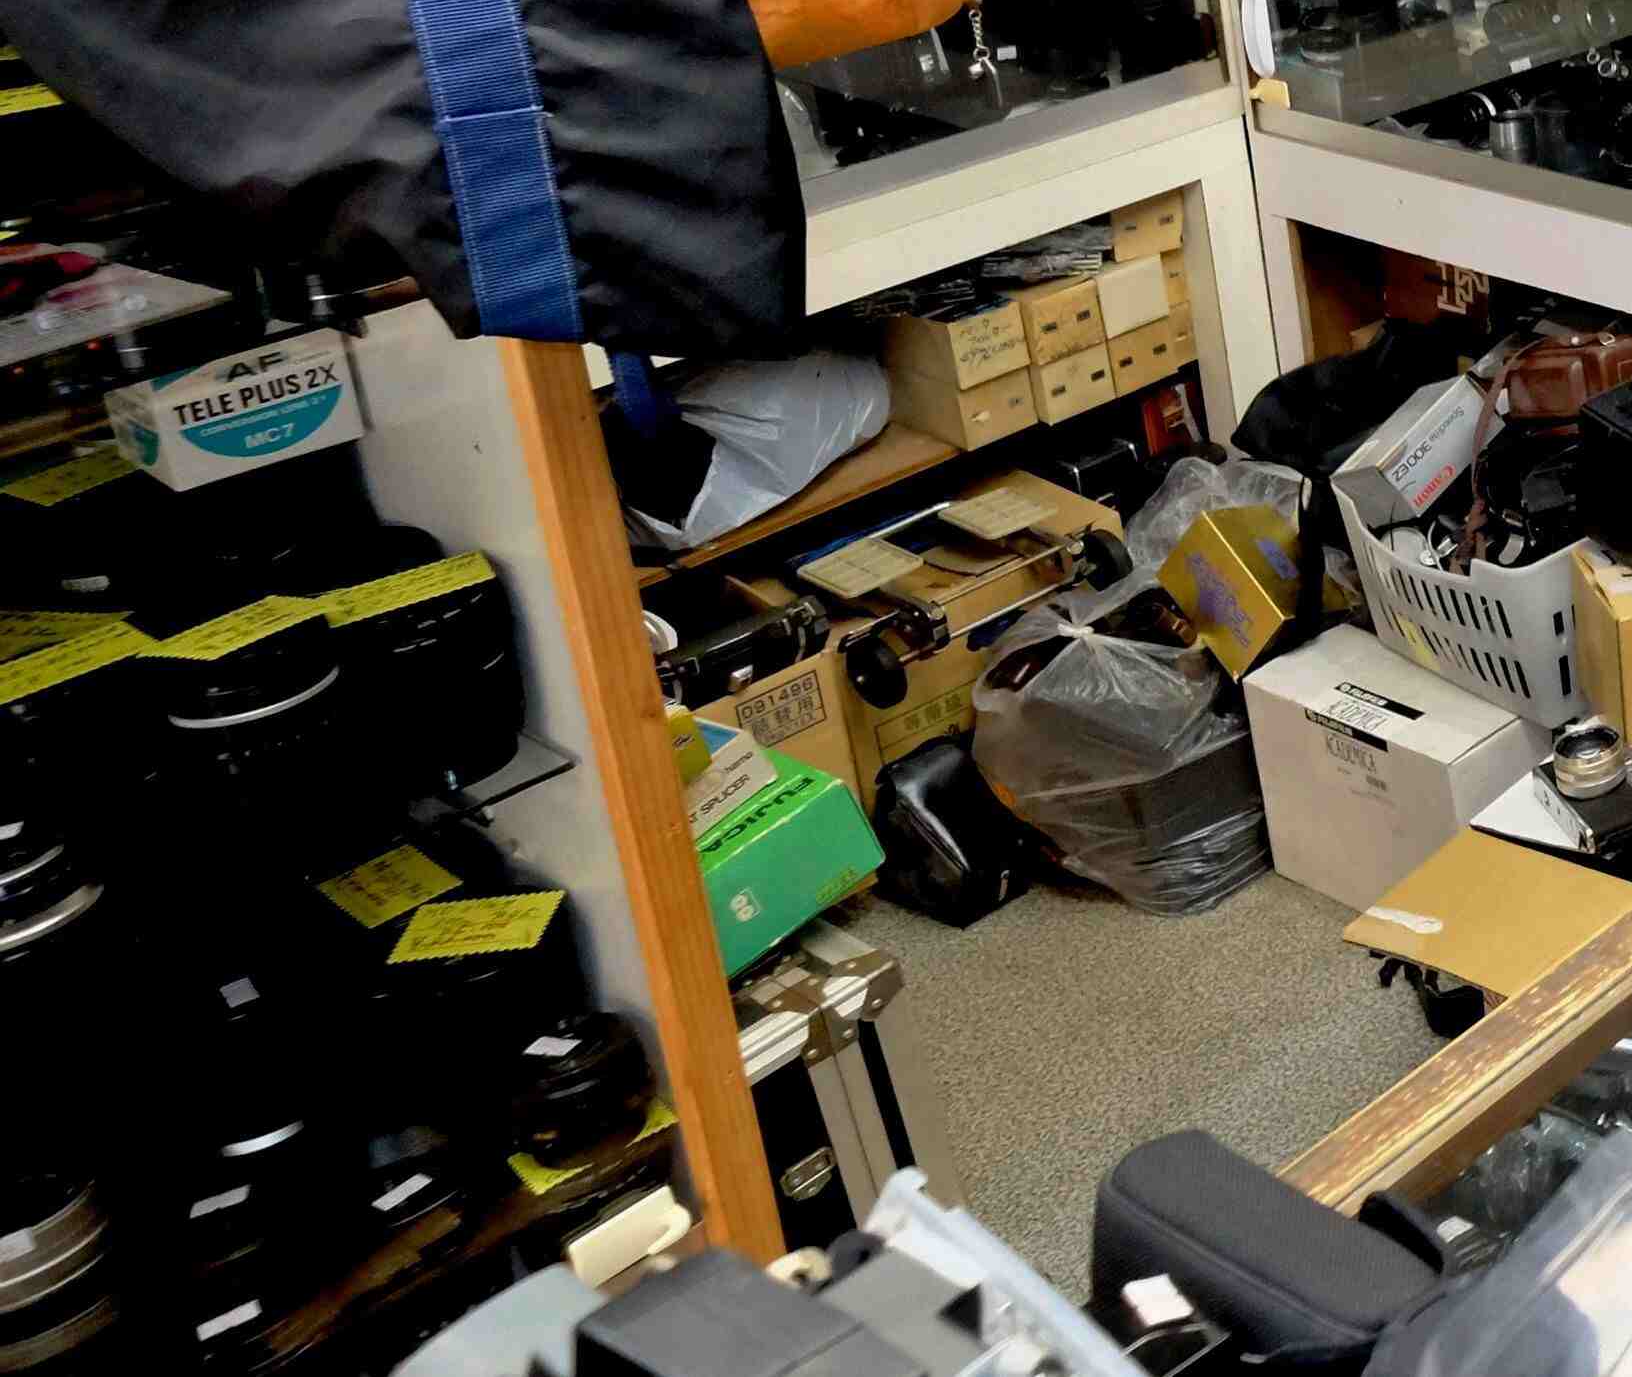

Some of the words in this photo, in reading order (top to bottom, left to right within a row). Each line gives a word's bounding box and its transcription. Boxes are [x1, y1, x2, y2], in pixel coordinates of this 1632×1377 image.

[226, 351, 285, 382] AF
[173, 393, 235, 426] TELE
[238, 373, 302, 410] PLUS
[304, 361, 340, 390] 2X
[1391, 439, 1434, 483] 300EZ
[1412, 462, 1457, 509] Canon
[701, 772, 751, 816] SPLICER
